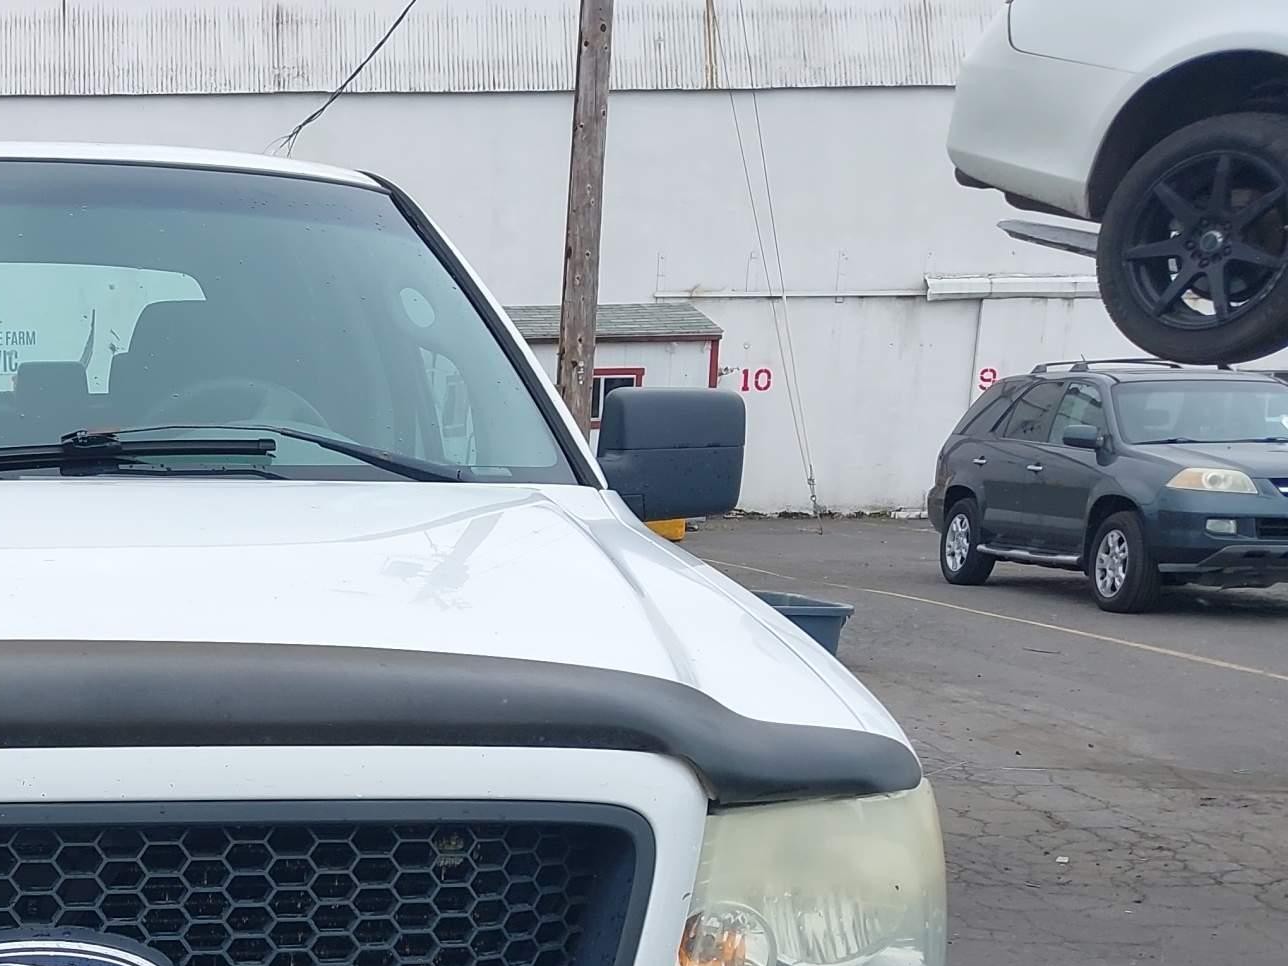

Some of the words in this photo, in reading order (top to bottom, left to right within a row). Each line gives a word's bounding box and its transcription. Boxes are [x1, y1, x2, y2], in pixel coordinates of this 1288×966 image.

[5, 330, 36, 346] FARM
[741, 368, 772, 392] 10
[978, 368, 997, 391] 9
